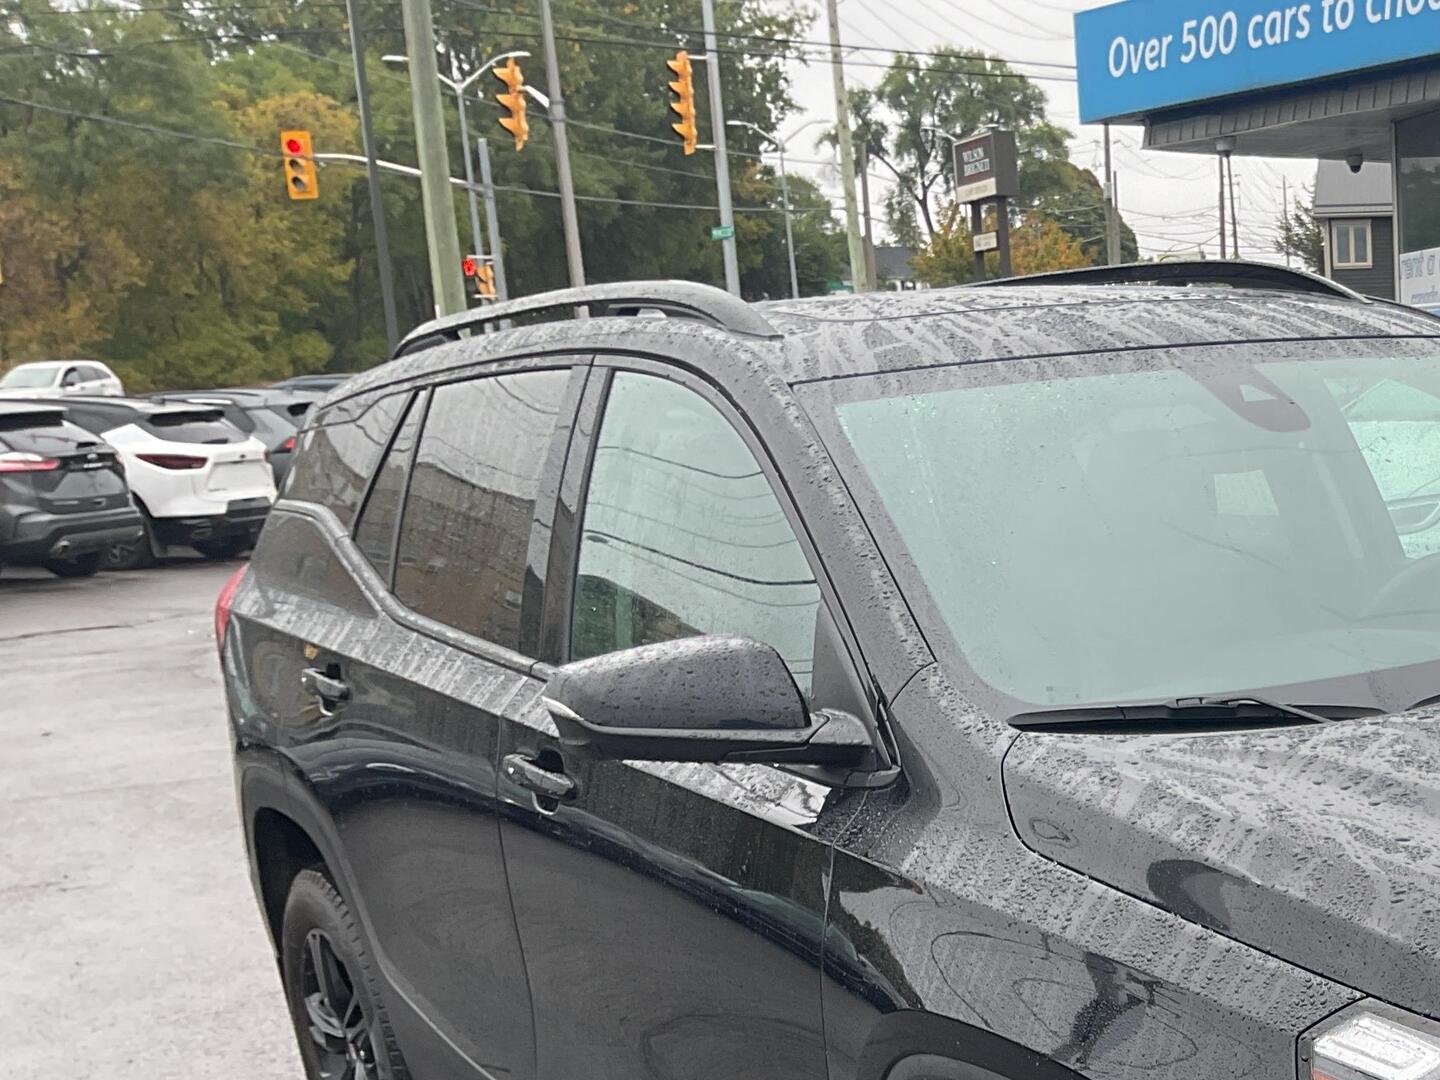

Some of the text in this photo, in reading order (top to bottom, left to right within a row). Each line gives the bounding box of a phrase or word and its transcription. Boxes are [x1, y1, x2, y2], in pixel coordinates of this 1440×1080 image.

[1108, 34, 1173, 78] Over
[1180, 10, 1238, 63] 500
[1247, 2, 1311, 49] cars
[1321, 0, 1354, 33] to
